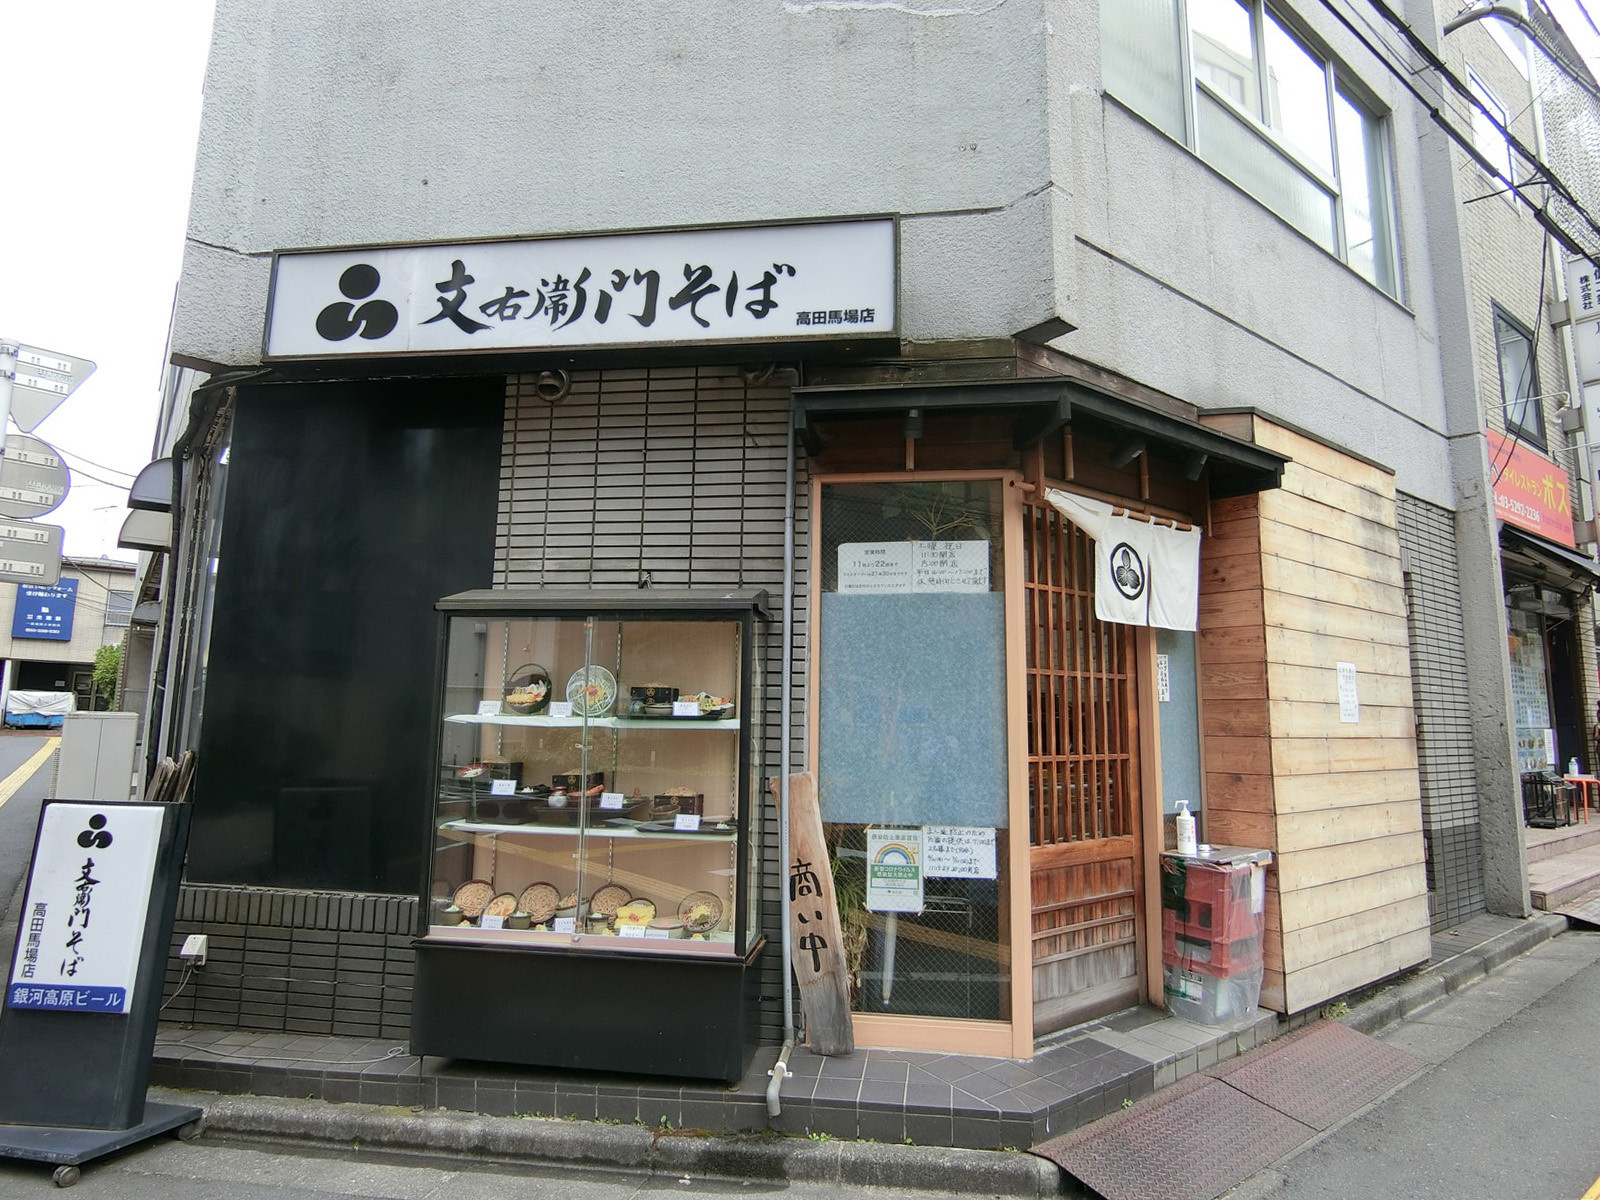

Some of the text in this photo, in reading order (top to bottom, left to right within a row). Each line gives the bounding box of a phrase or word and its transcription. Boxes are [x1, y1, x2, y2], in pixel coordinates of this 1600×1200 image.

[1579, 274, 1593, 310] 株式会社
[796, 308, 875, 326] 高田馬場店
[789, 857, 828, 972] 商い中
[21, 902, 48, 978] 高田馬場店
[13, 987, 121, 1006] 銀河高原ビール
